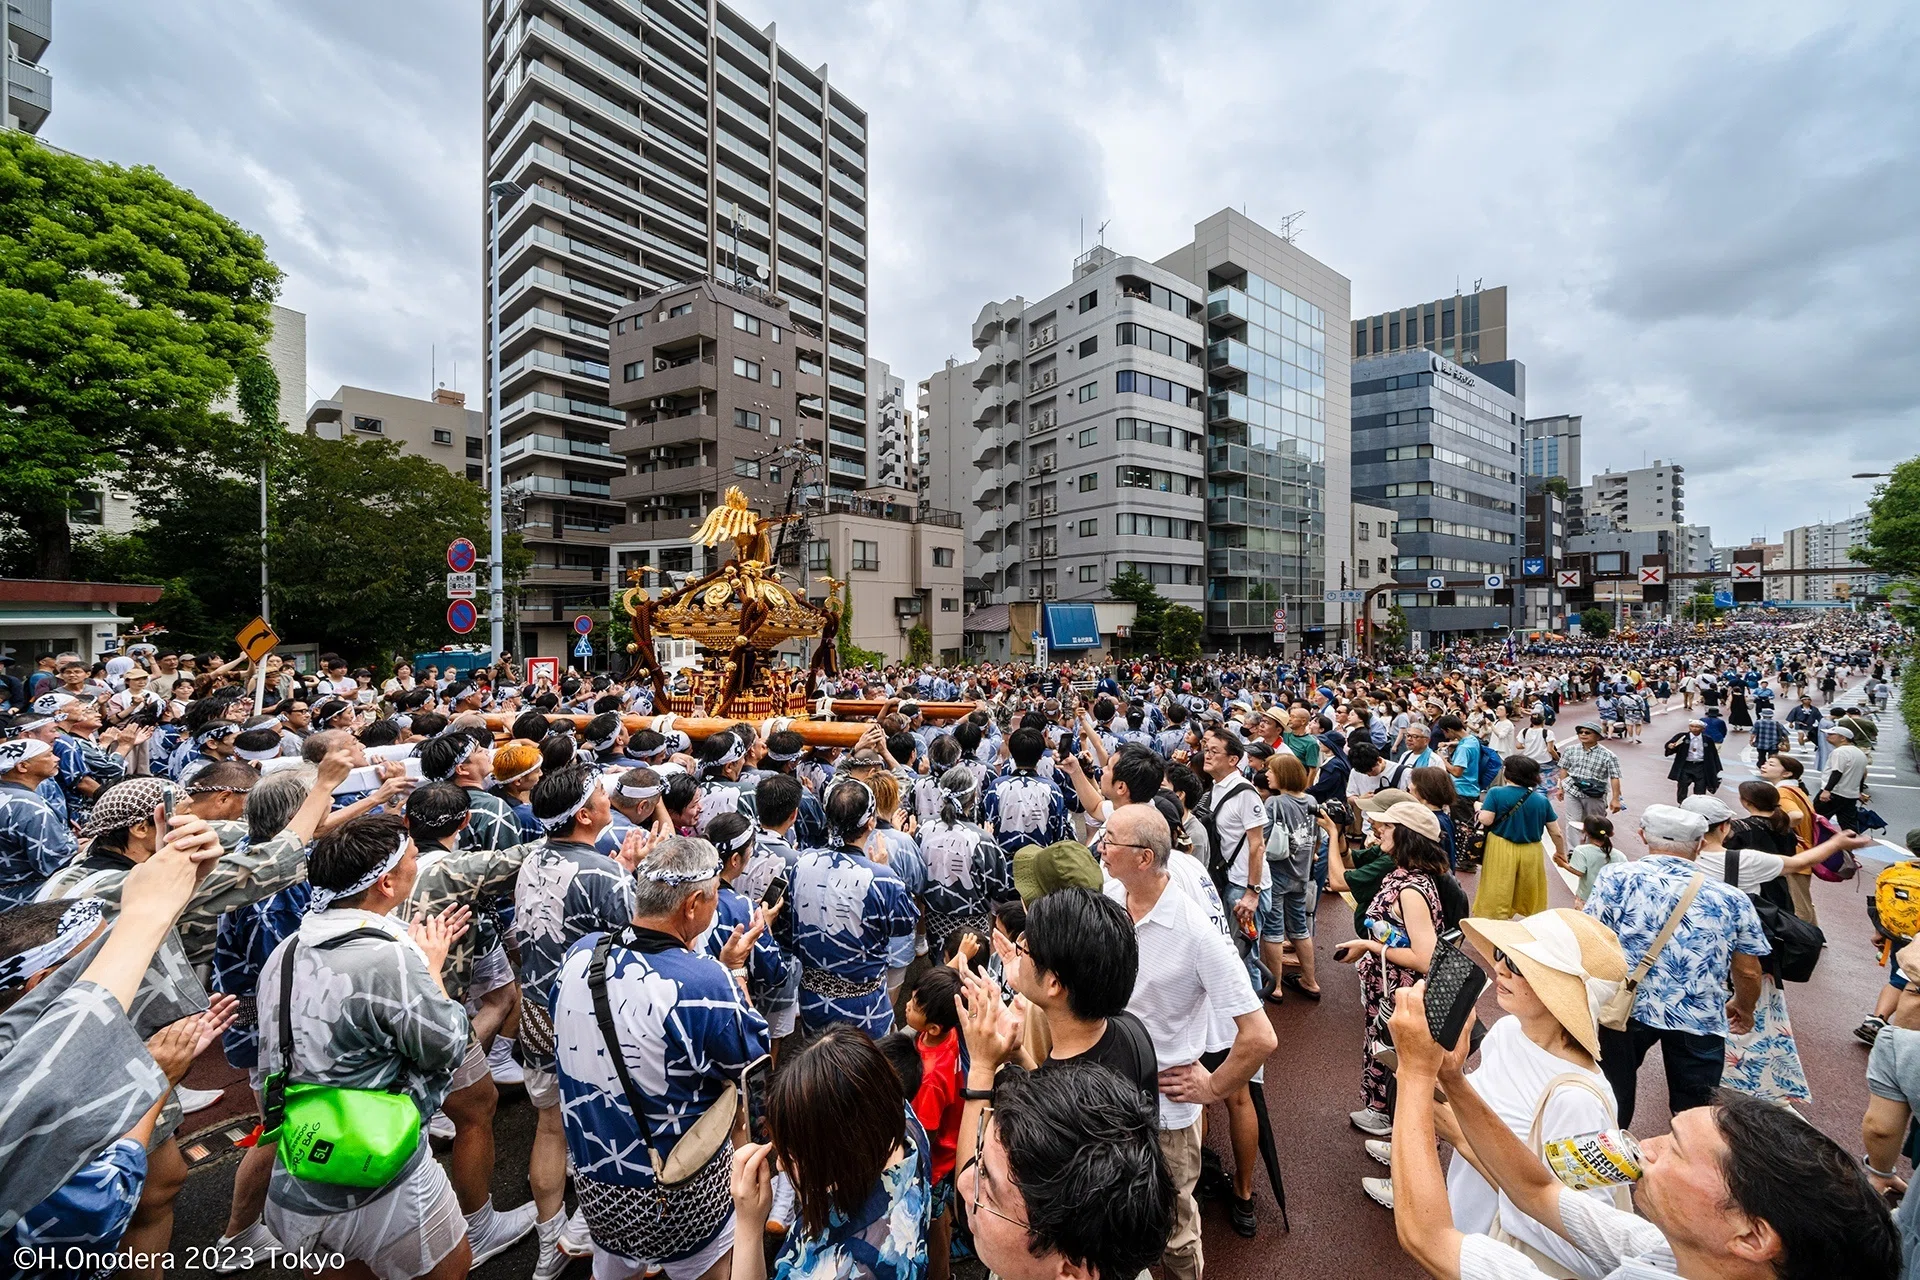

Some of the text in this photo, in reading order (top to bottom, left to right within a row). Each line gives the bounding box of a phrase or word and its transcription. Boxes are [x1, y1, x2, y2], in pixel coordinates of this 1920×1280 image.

[302, 1122, 321, 1146] BAG
[314, 1146, 330, 1160] 5L
[1578, 1145, 1608, 1175] ZERO
[1586, 1140, 1632, 1182] STRONG
